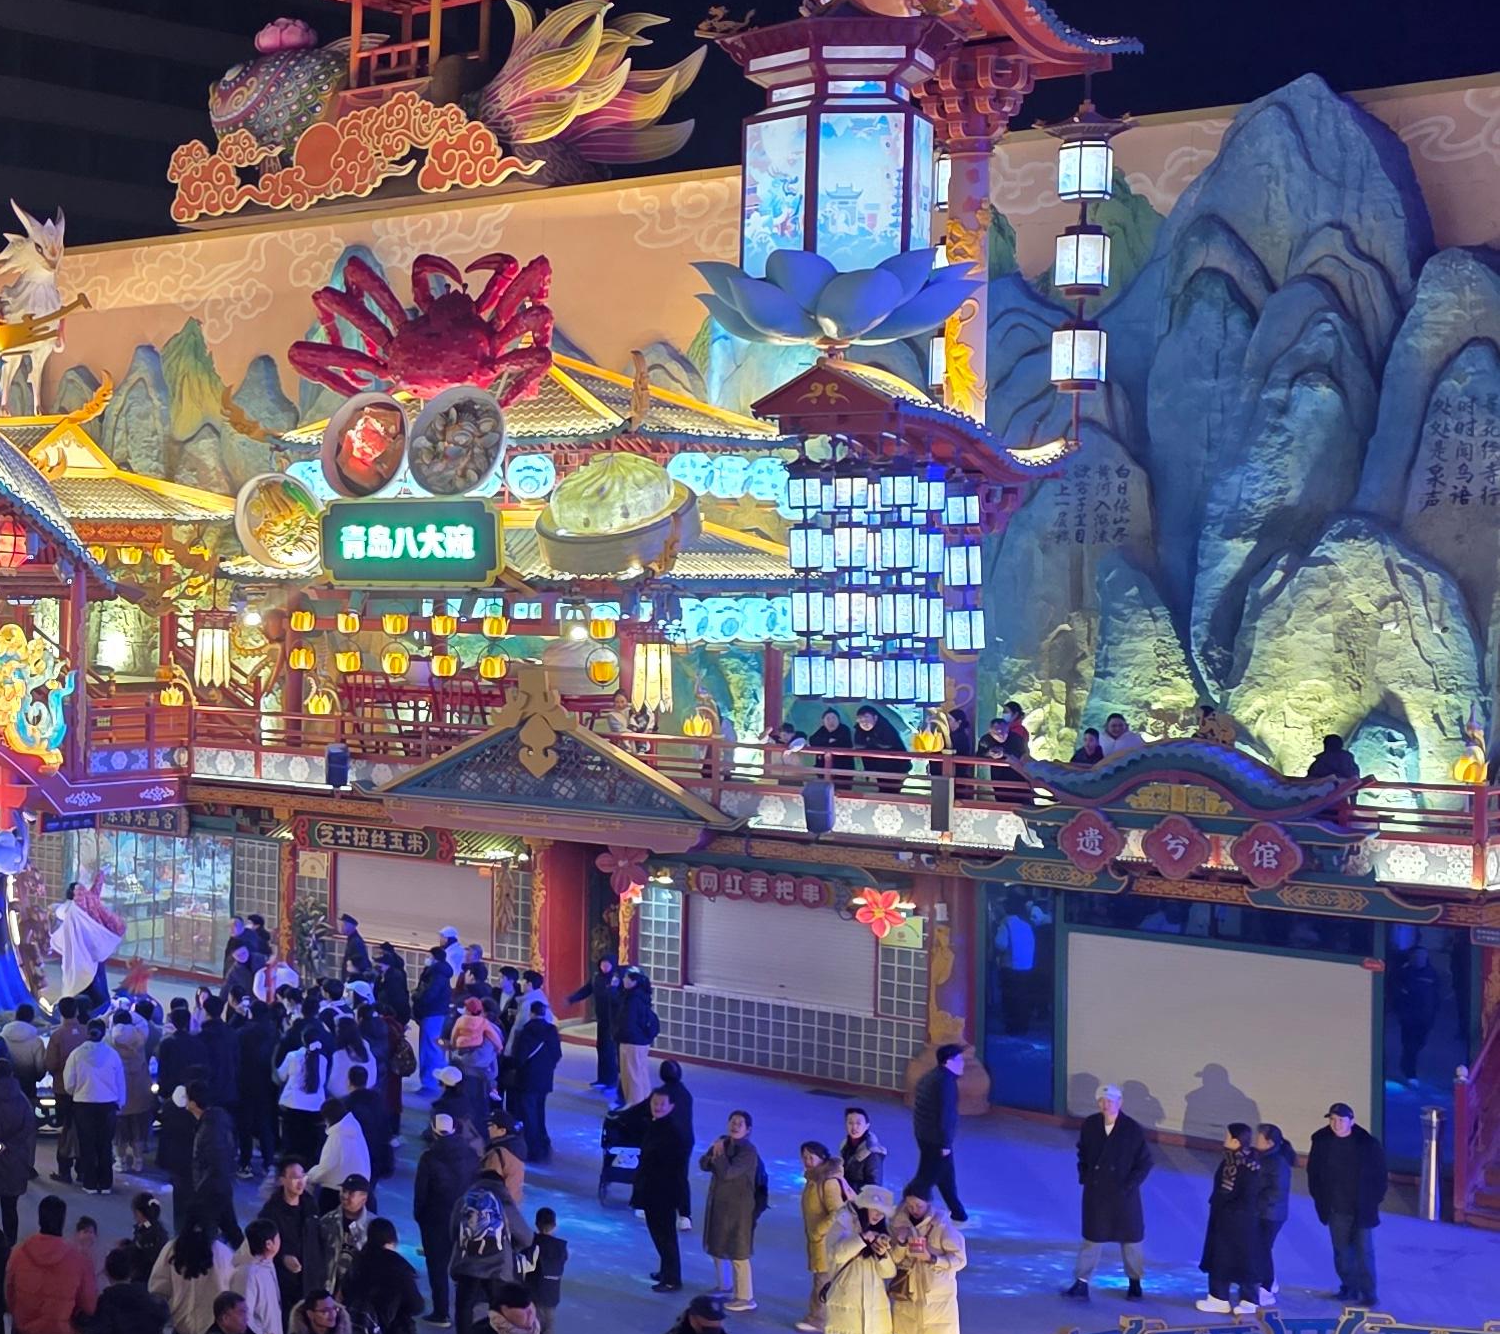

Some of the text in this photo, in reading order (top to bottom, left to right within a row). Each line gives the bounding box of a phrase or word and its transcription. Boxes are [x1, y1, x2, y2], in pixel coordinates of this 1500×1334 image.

[340, 523, 476, 560] 青岛八大碗
[318, 824, 425, 853] 芝士拉丝玉米
[700, 872, 822, 903] 网红手把串
